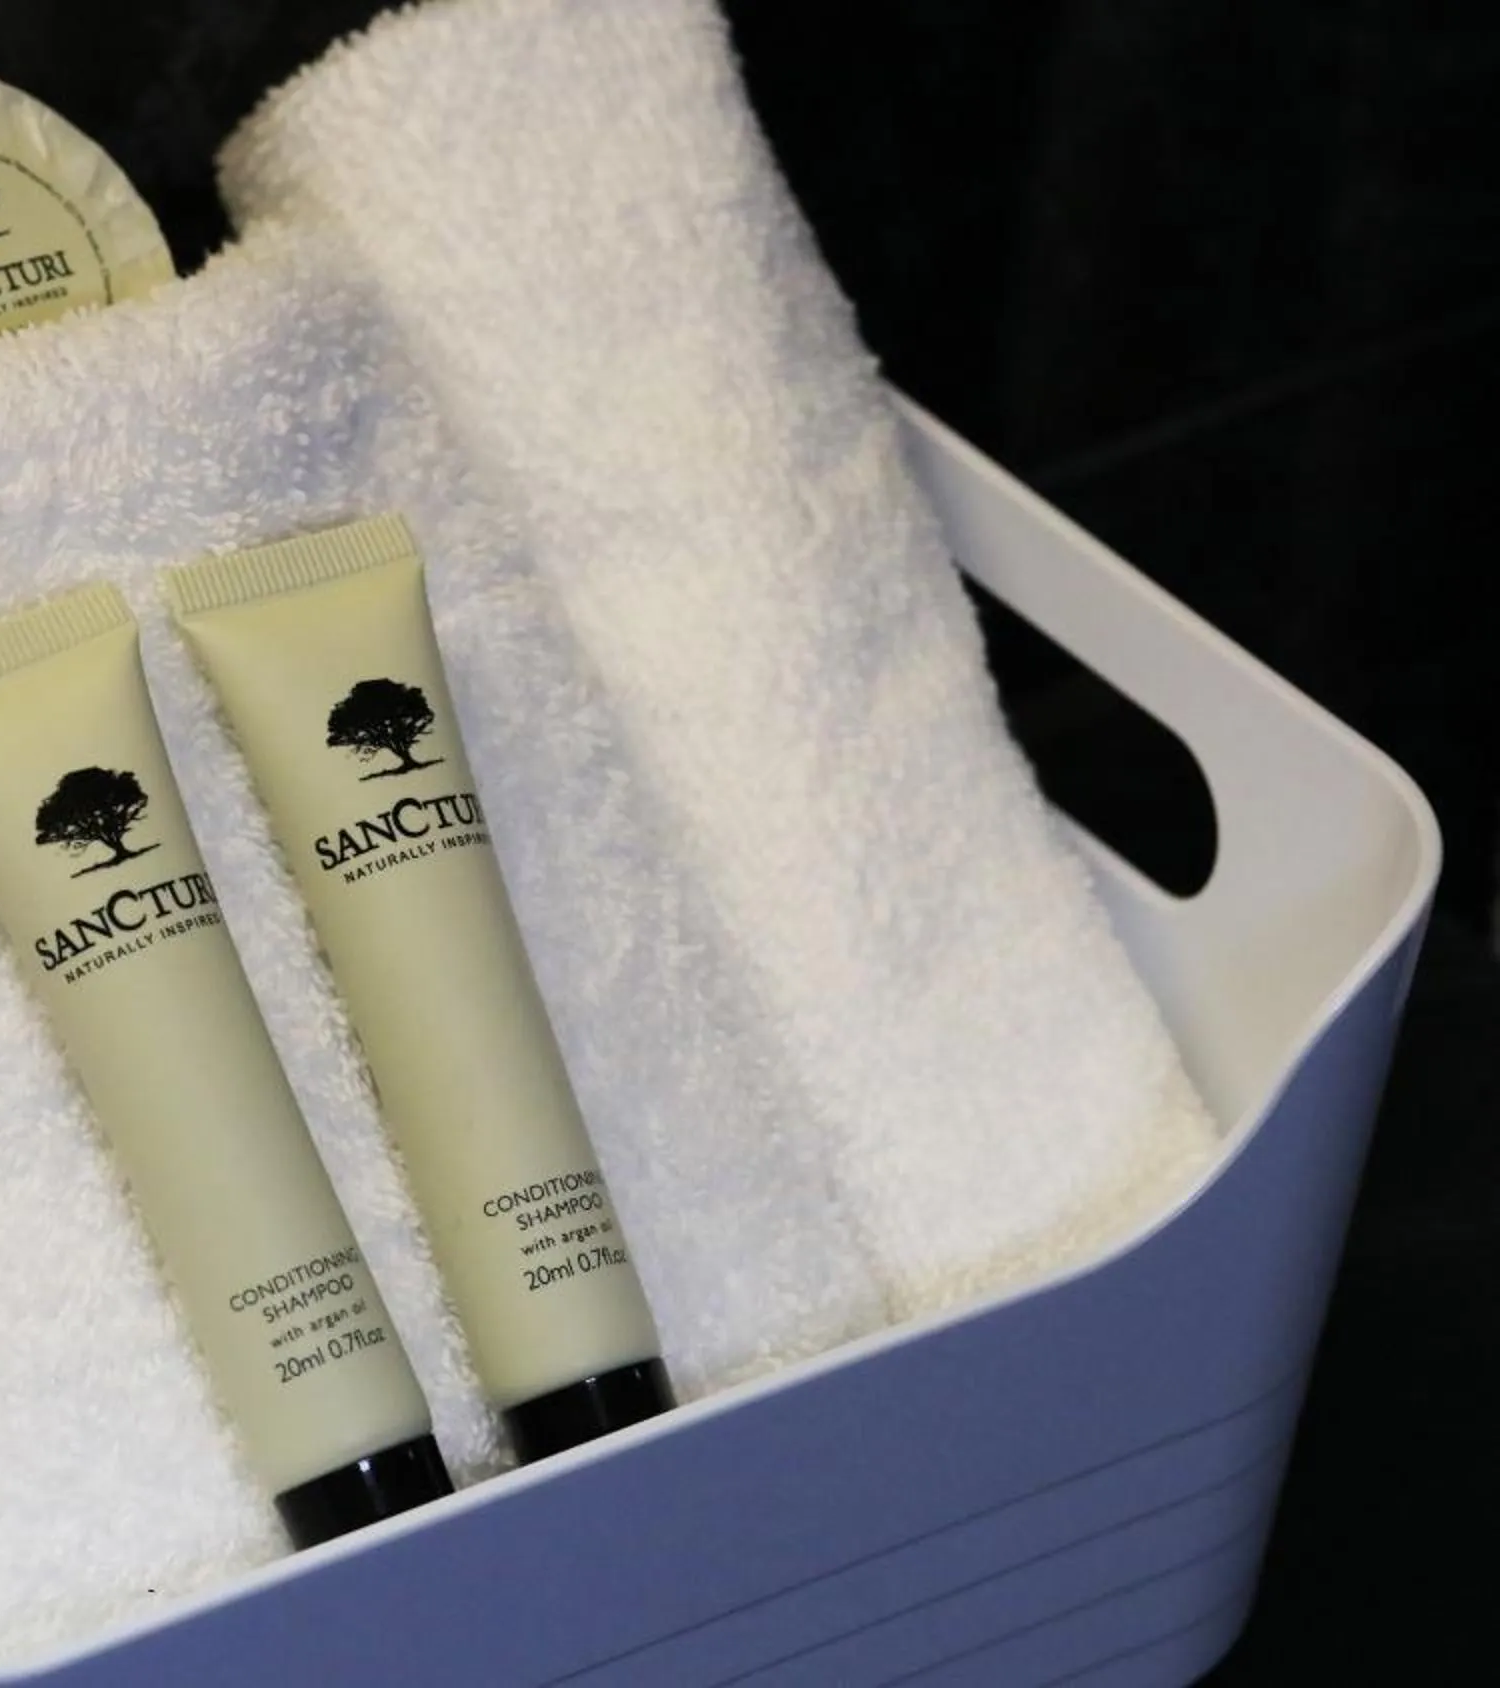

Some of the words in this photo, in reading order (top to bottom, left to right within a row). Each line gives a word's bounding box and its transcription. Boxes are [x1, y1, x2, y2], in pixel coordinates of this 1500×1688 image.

[343, 841, 435, 884] NATURALLY
[64, 932, 154, 984] NATURALLY
[516, 1191, 603, 1231] SHAMPOO
[521, 1236, 557, 1256] with
[561, 1224, 599, 1242] argan
[524, 1256, 575, 1291] 20ml
[262, 1274, 354, 1323] SHAMPOO
[270, 1325, 304, 1348] with
[309, 1307, 349, 1331] argan
[275, 1346, 326, 1384] 20ml
